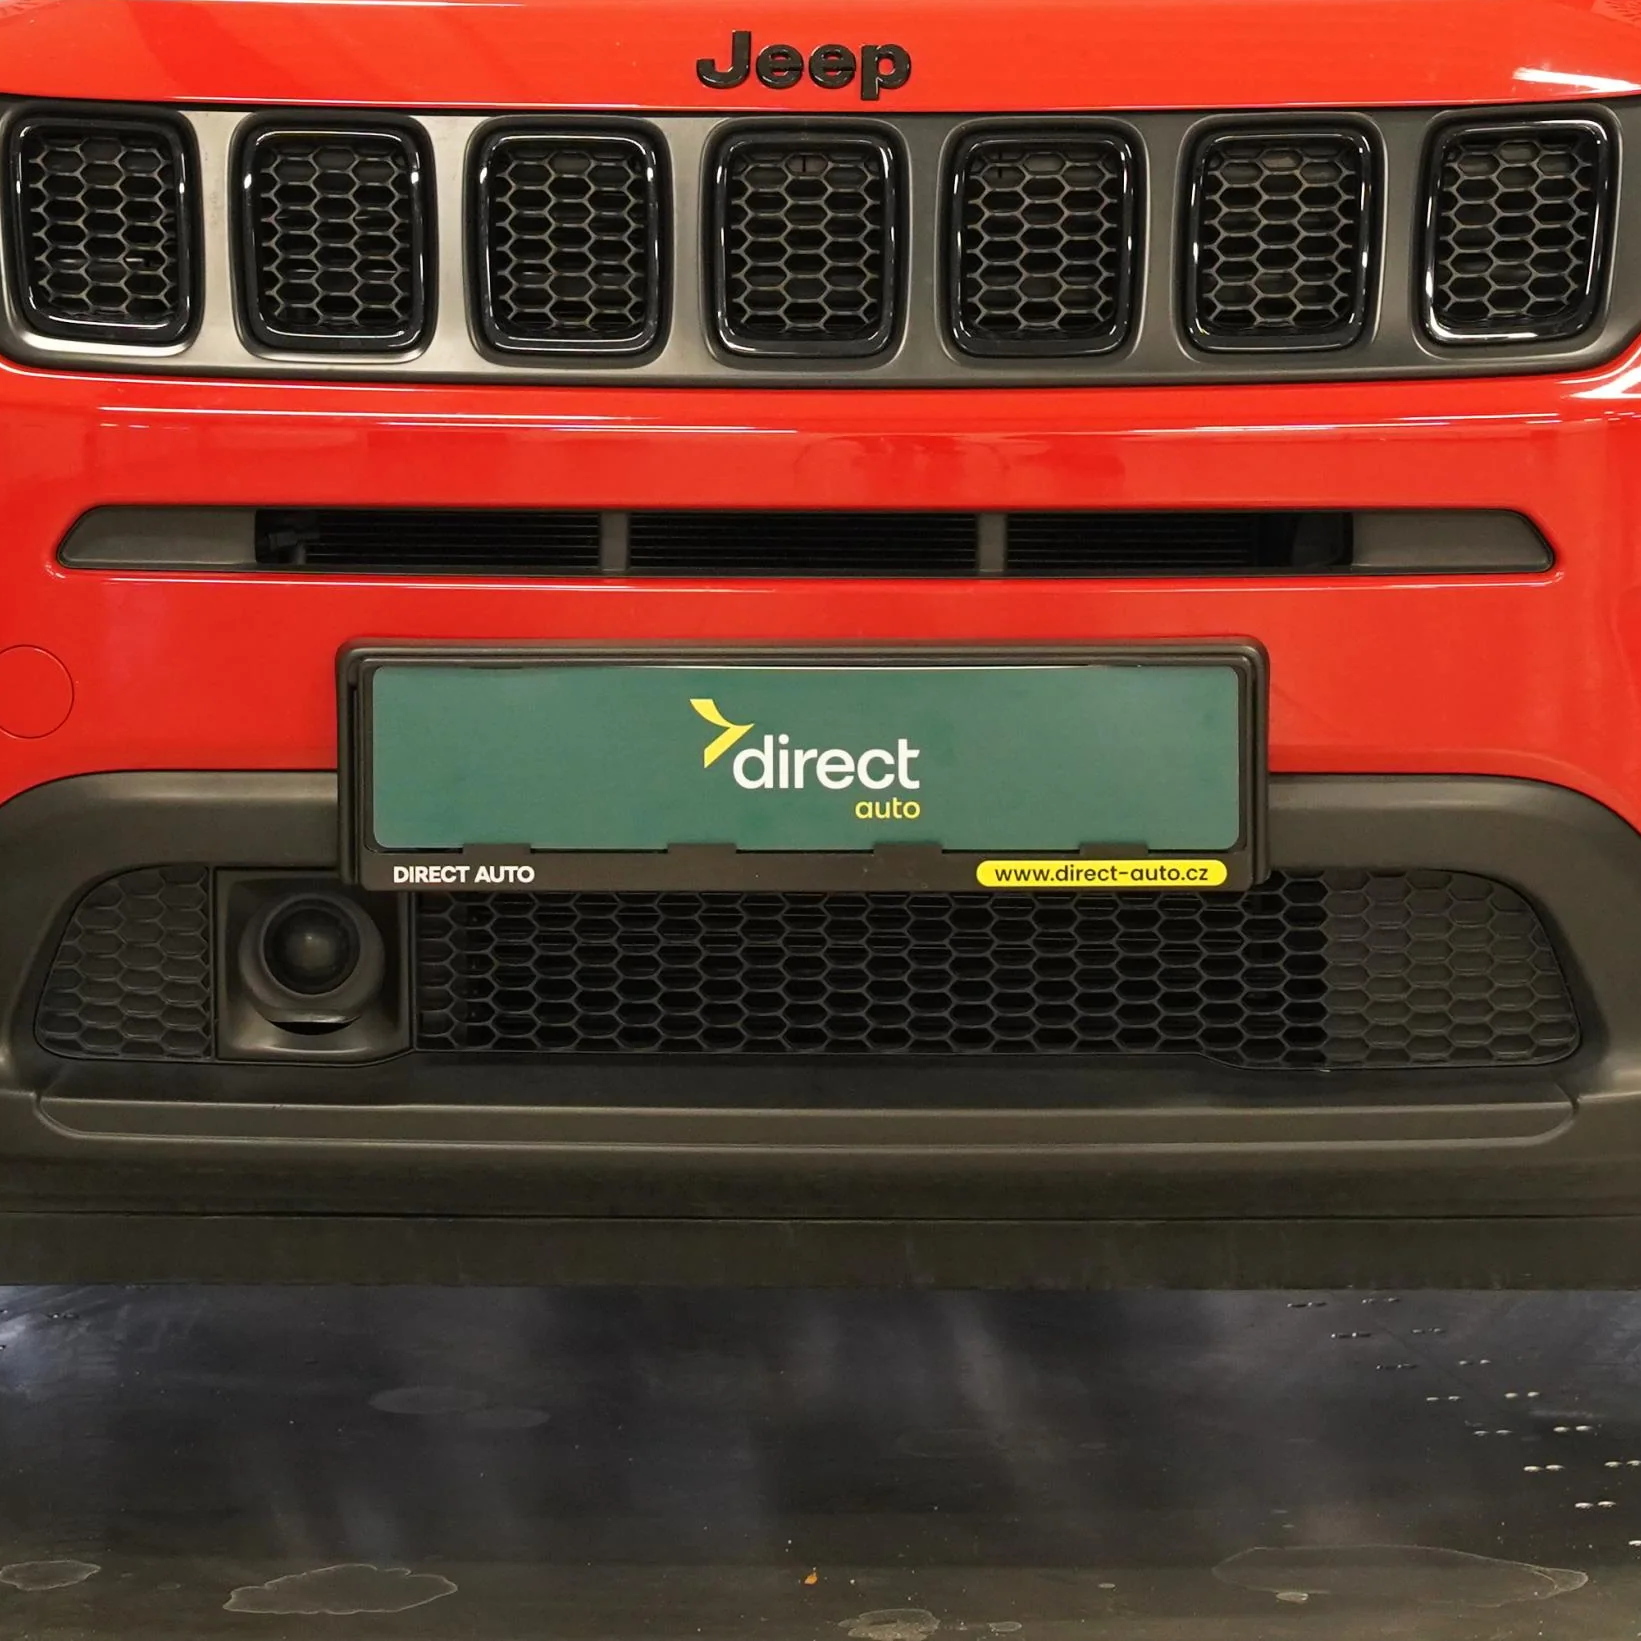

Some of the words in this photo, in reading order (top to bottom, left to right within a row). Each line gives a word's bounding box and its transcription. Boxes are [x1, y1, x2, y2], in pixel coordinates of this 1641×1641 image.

[696, 29, 912, 101] Jeep
[732, 733, 921, 790] direct
[854, 796, 921, 820] auto
[393, 865, 471, 883] DIRECT
[474, 865, 536, 883] AUTO
[994, 863, 1209, 882] www.direct-auto.cz
